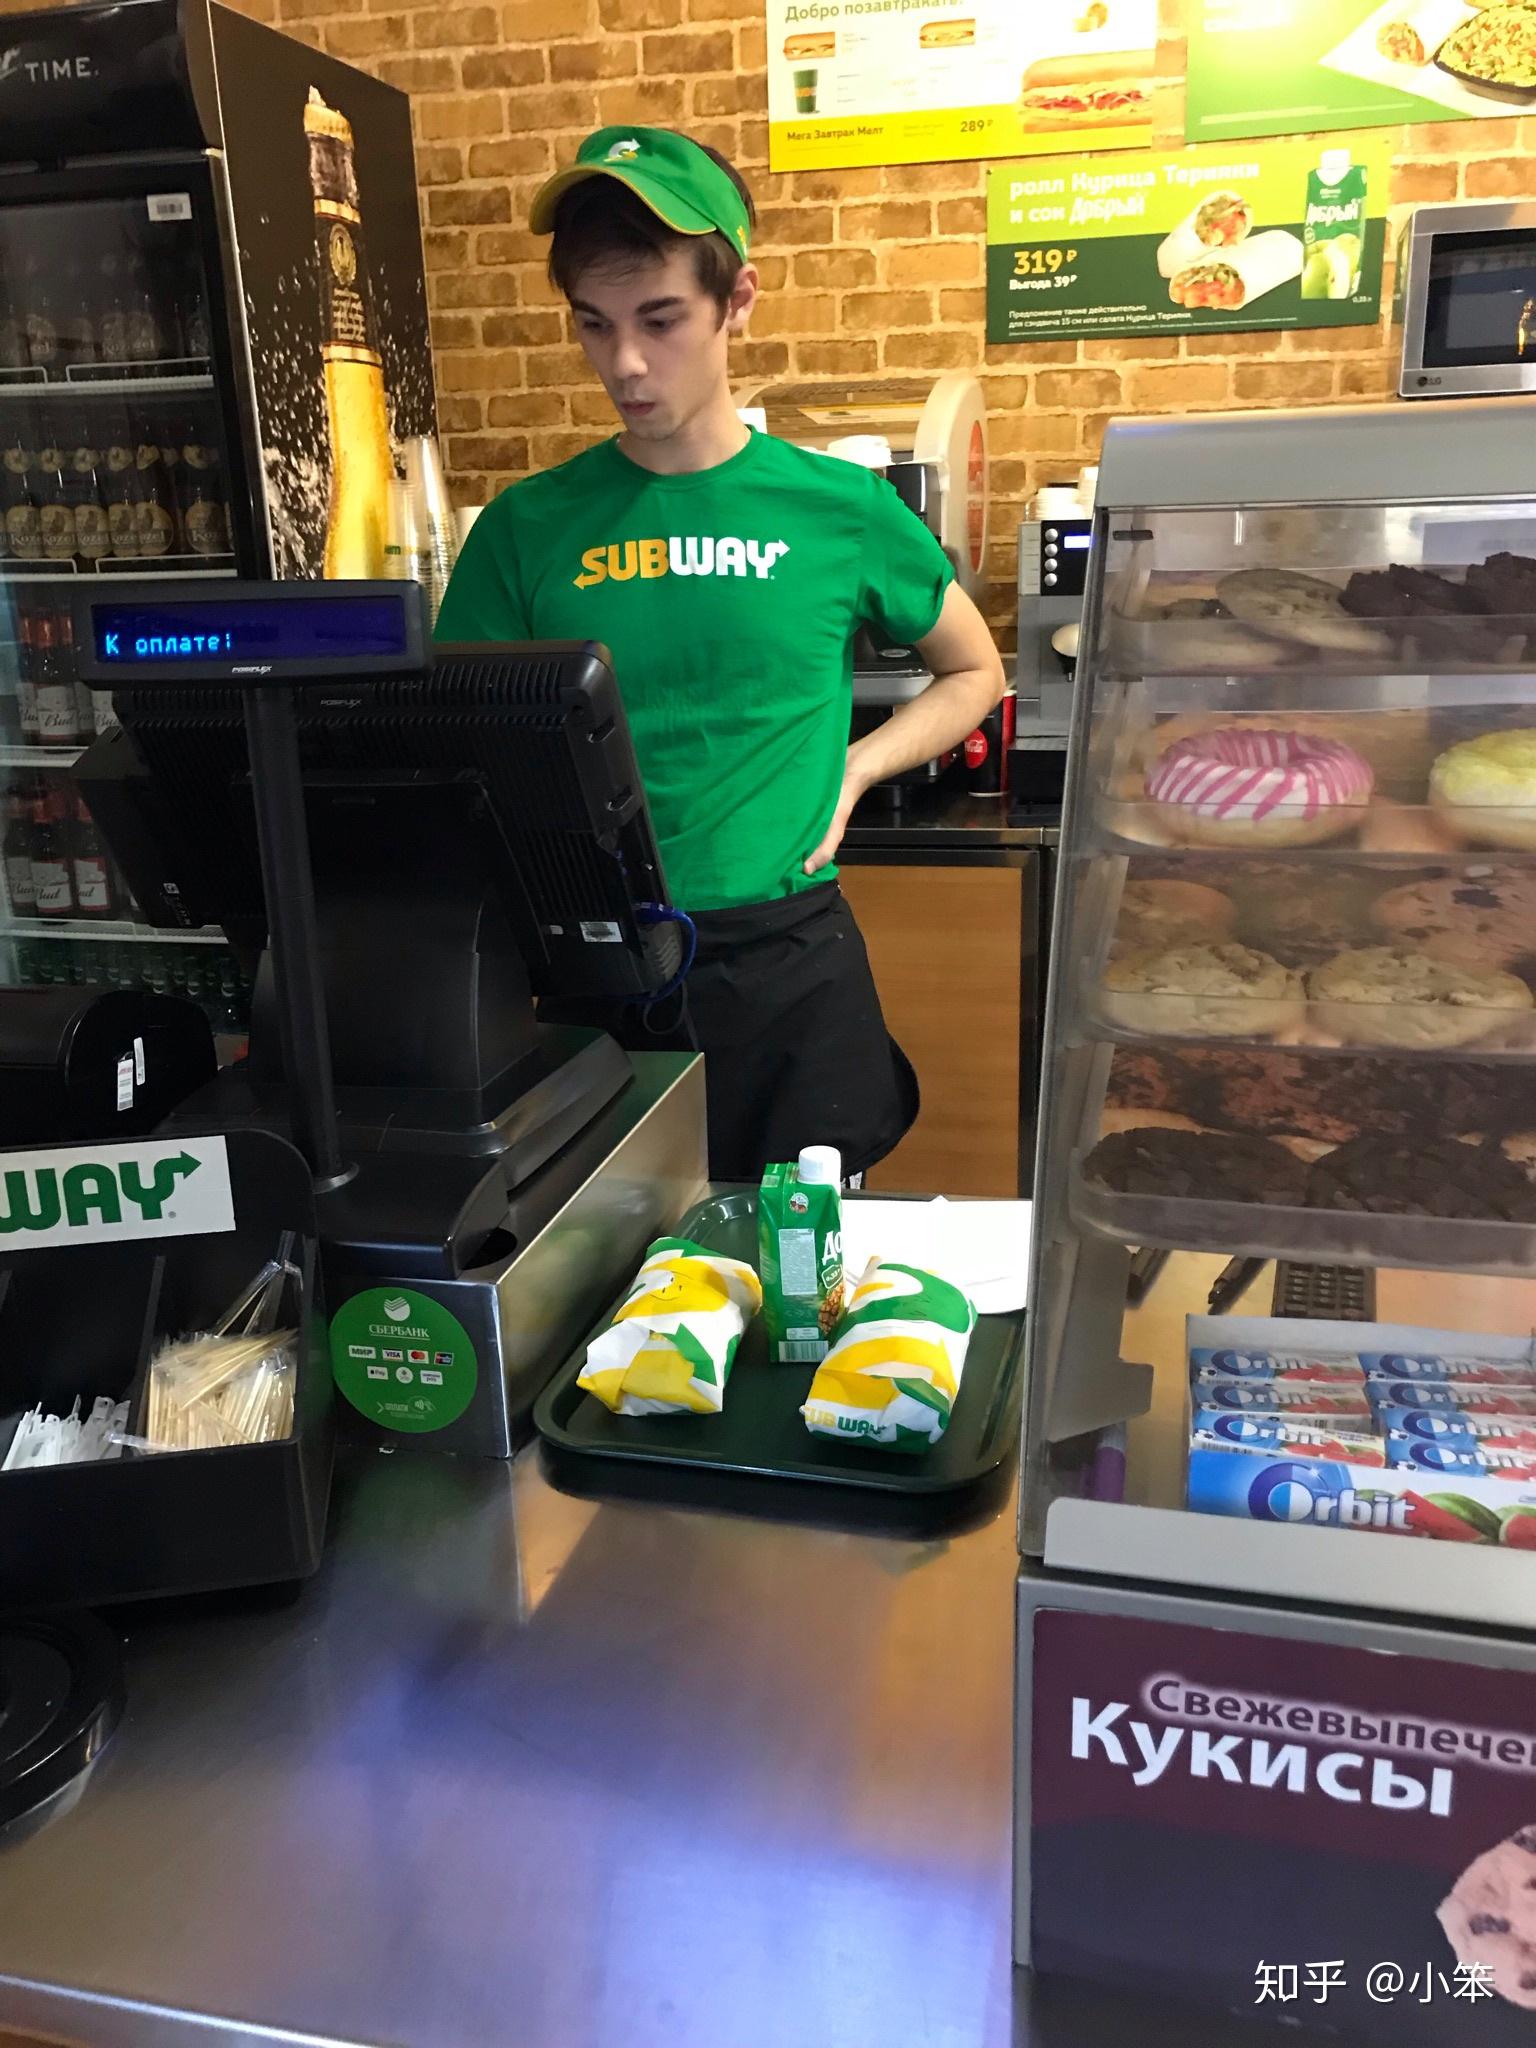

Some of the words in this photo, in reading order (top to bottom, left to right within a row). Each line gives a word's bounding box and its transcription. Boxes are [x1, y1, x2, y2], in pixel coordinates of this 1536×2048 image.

[785, 4, 839, 23] Добро
[1010, 178, 1065, 200] ролл
[1071, 169, 1156, 194] Курица
[1029, 206, 1066, 222] сок
[1009, 278, 1052, 291] Выгода
[572, 536, 791, 591] SUBWAY
[106, 633, 119, 655] К
[368, 1323, 431, 1339] СБЕРБАНК
[1248, 1462, 1417, 1530] Orbit
[1149, 1678, 1536, 1767] Свежевыпече
[1071, 1697, 1454, 1817] Кукисы
